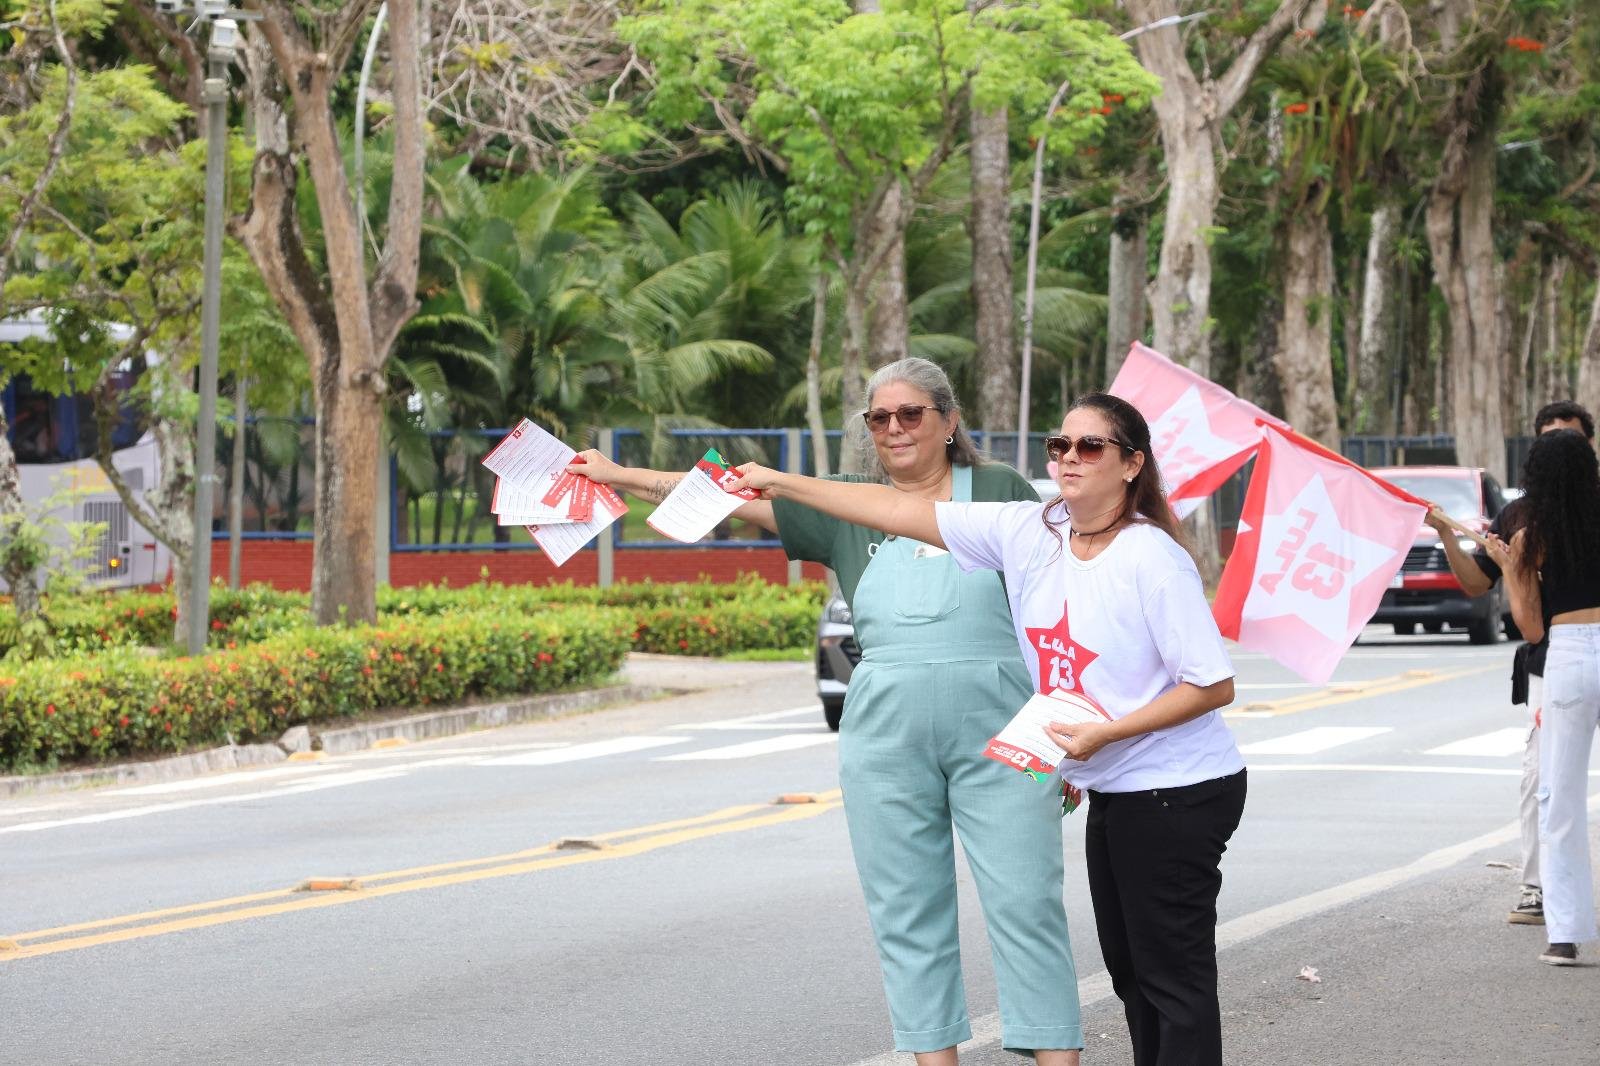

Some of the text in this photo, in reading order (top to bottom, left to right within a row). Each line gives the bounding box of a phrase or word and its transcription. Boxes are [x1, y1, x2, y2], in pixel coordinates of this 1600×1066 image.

[512, 429, 522, 440] 13
[1039, 634, 1076, 661] LULA
[1048, 655, 1076, 690] 13
[1010, 751, 1034, 768] 13
